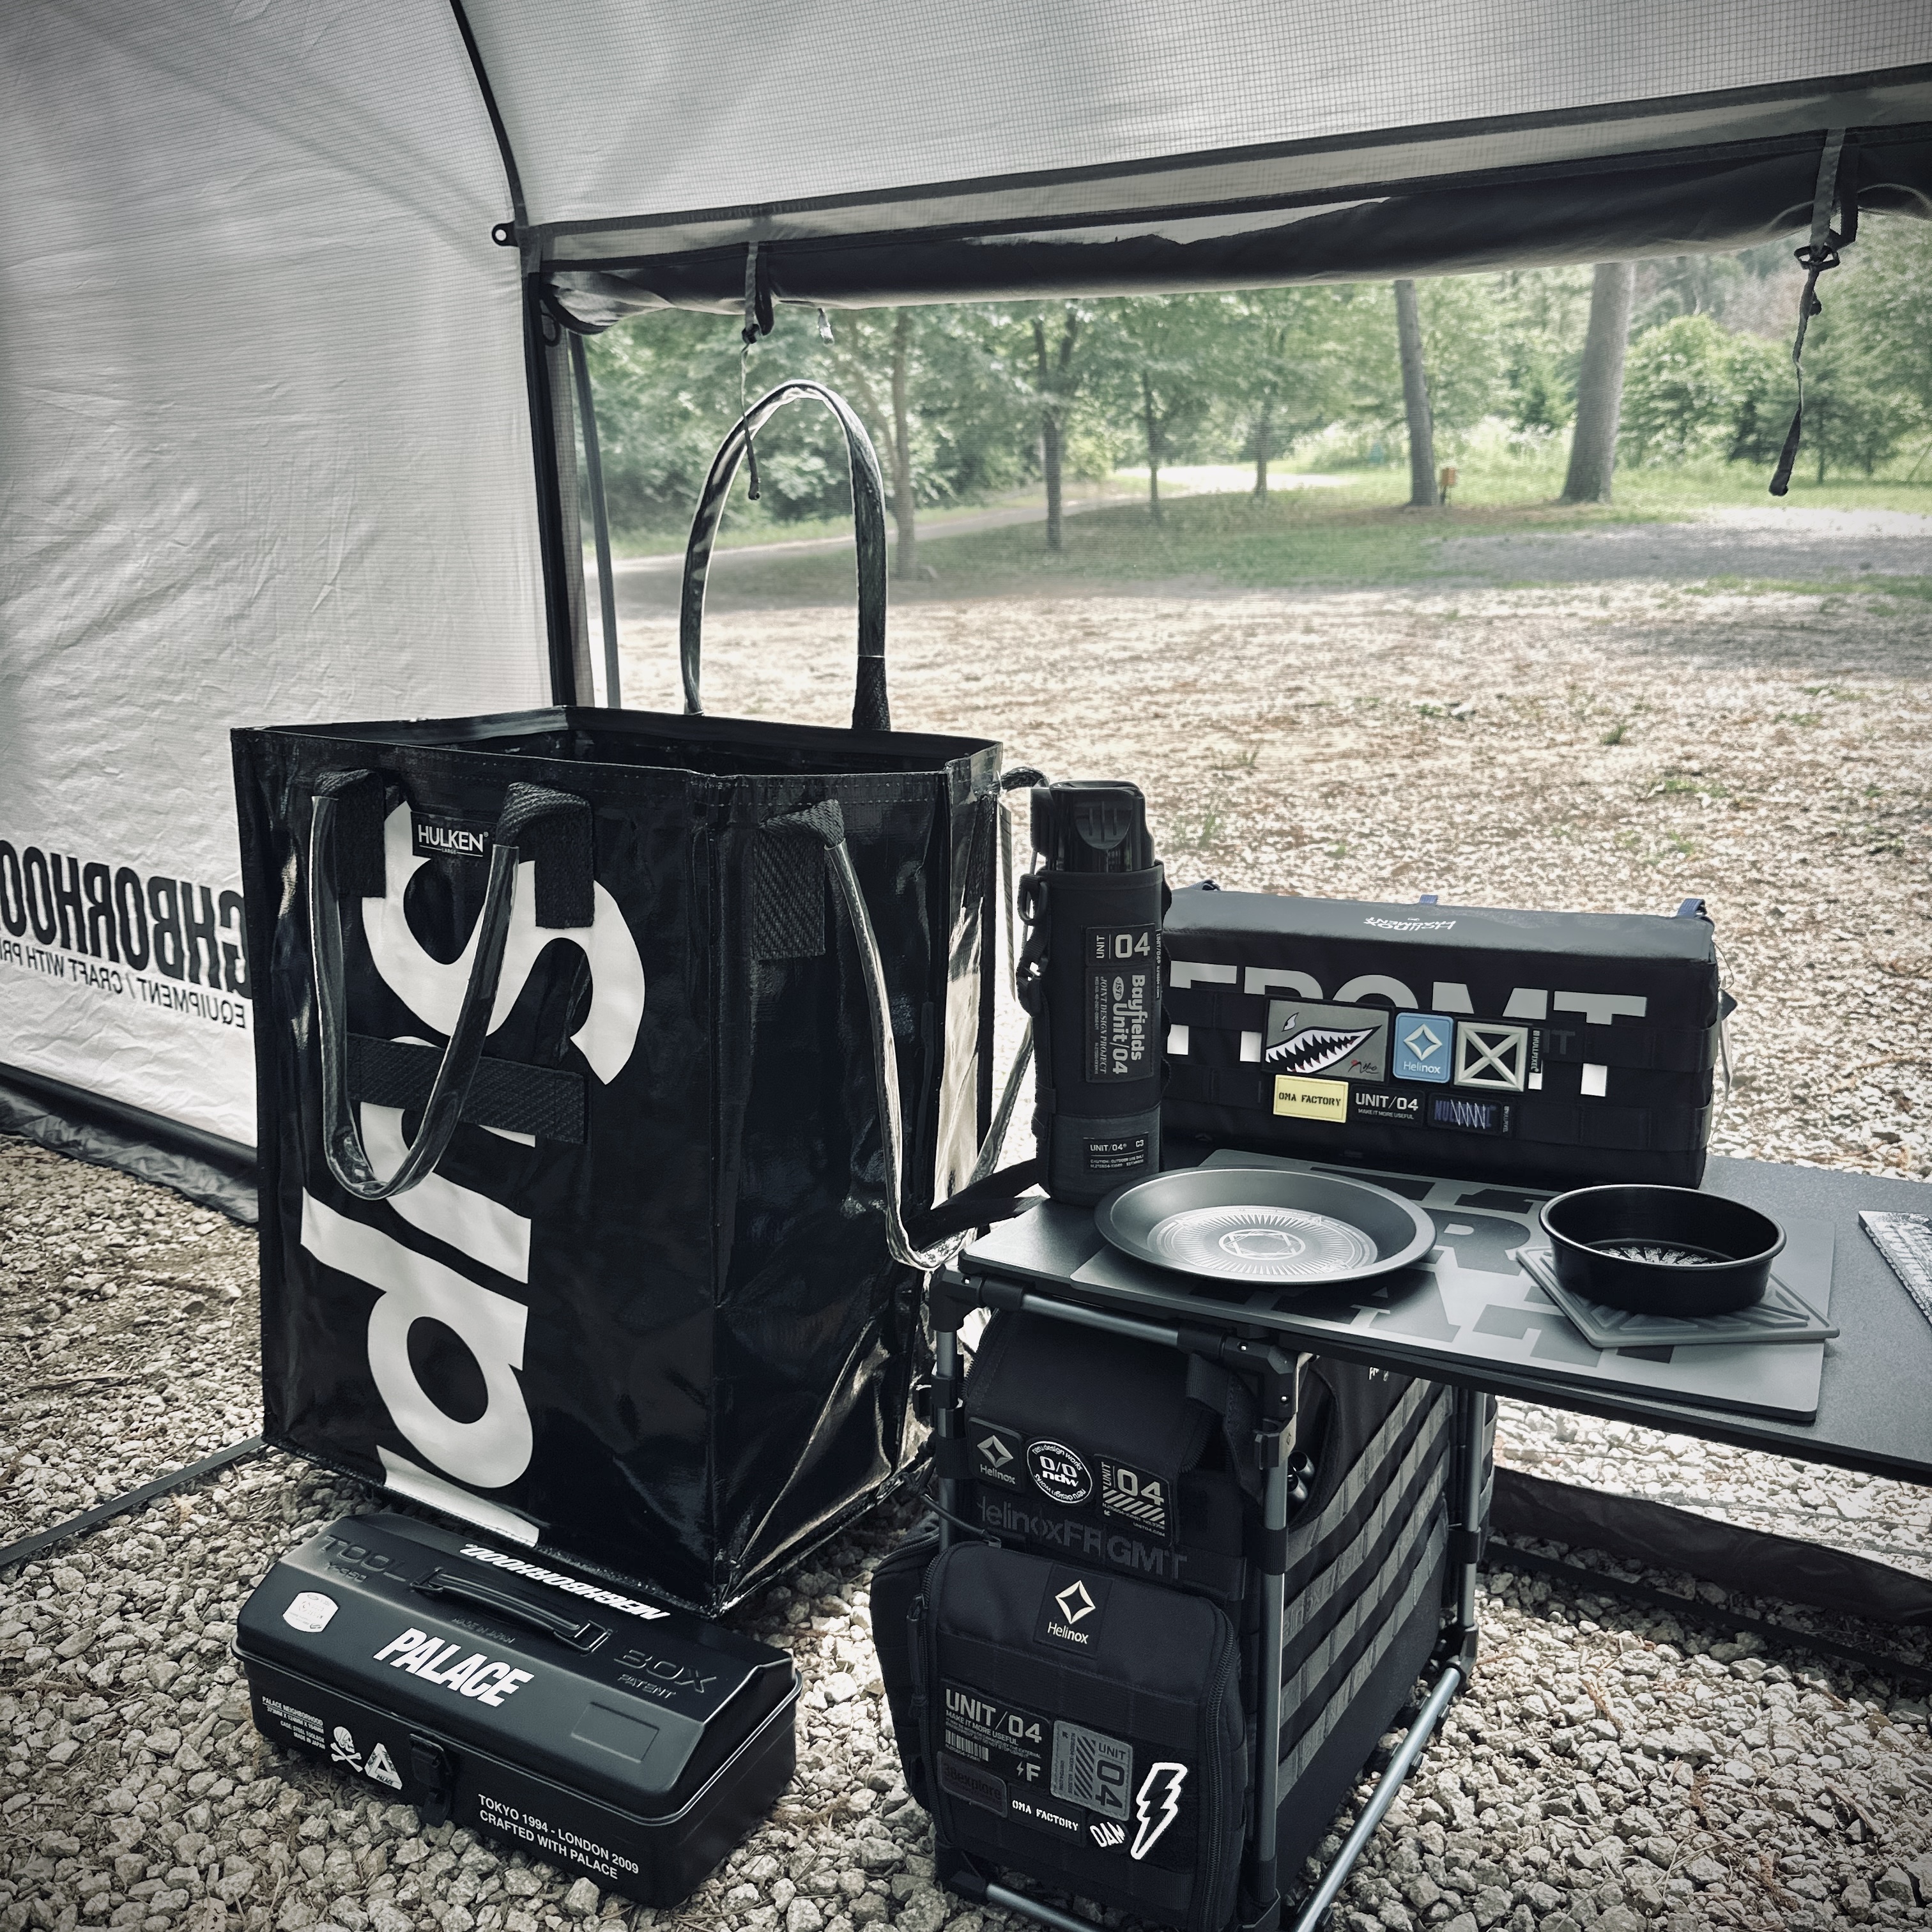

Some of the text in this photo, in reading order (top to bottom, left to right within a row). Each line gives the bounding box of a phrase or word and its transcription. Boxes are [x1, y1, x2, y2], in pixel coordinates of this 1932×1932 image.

[418, 824, 484, 853] HULKEN
[1096, 932, 1150, 958] UNIT 04
[1128, 974, 1148, 1061] Bayfields
[1109, 1003, 1130, 1074] Unit/04
[1404, 1061, 1441, 1074] Helinox
[1301, 1095, 1341, 1107] FACTORY
[1355, 1092, 1418, 1111] UNIT/04
[980, 1463, 1016, 1485] Helinox
[1065, 1452, 1084, 1471] works
[1042, 1470, 1079, 1487] ndw
[1101, 1461, 1165, 1506] UNIT 04
[320, 1535, 406, 1583] TOOL
[459, 1546, 671, 1620] NEIGHBORHOOD
[1047, 1621, 1089, 1644] Helinox
[373, 1627, 535, 1707] PALACE
[617, 1673, 677, 1699] PATENT
[262, 1696, 282, 1710] PALACE
[946, 1689, 1042, 1744] UNIT/04
[946, 1709, 1019, 1746] MAKE IT MORE USEFUL
[1099, 1742, 1126, 1760] UNIT
[1026, 1762, 1041, 1781] F
[1095, 1759, 1124, 1809] 04
[1036, 1808, 1079, 1832] FACTORY
[479, 1793, 519, 1821] TOKYO
[523, 1814, 548, 1833] 1994
[558, 1828, 609, 1860] LONDON
[612, 1853, 639, 1874] 2009
[480, 1809, 618, 1880] CRAFTED WITH PALACE
